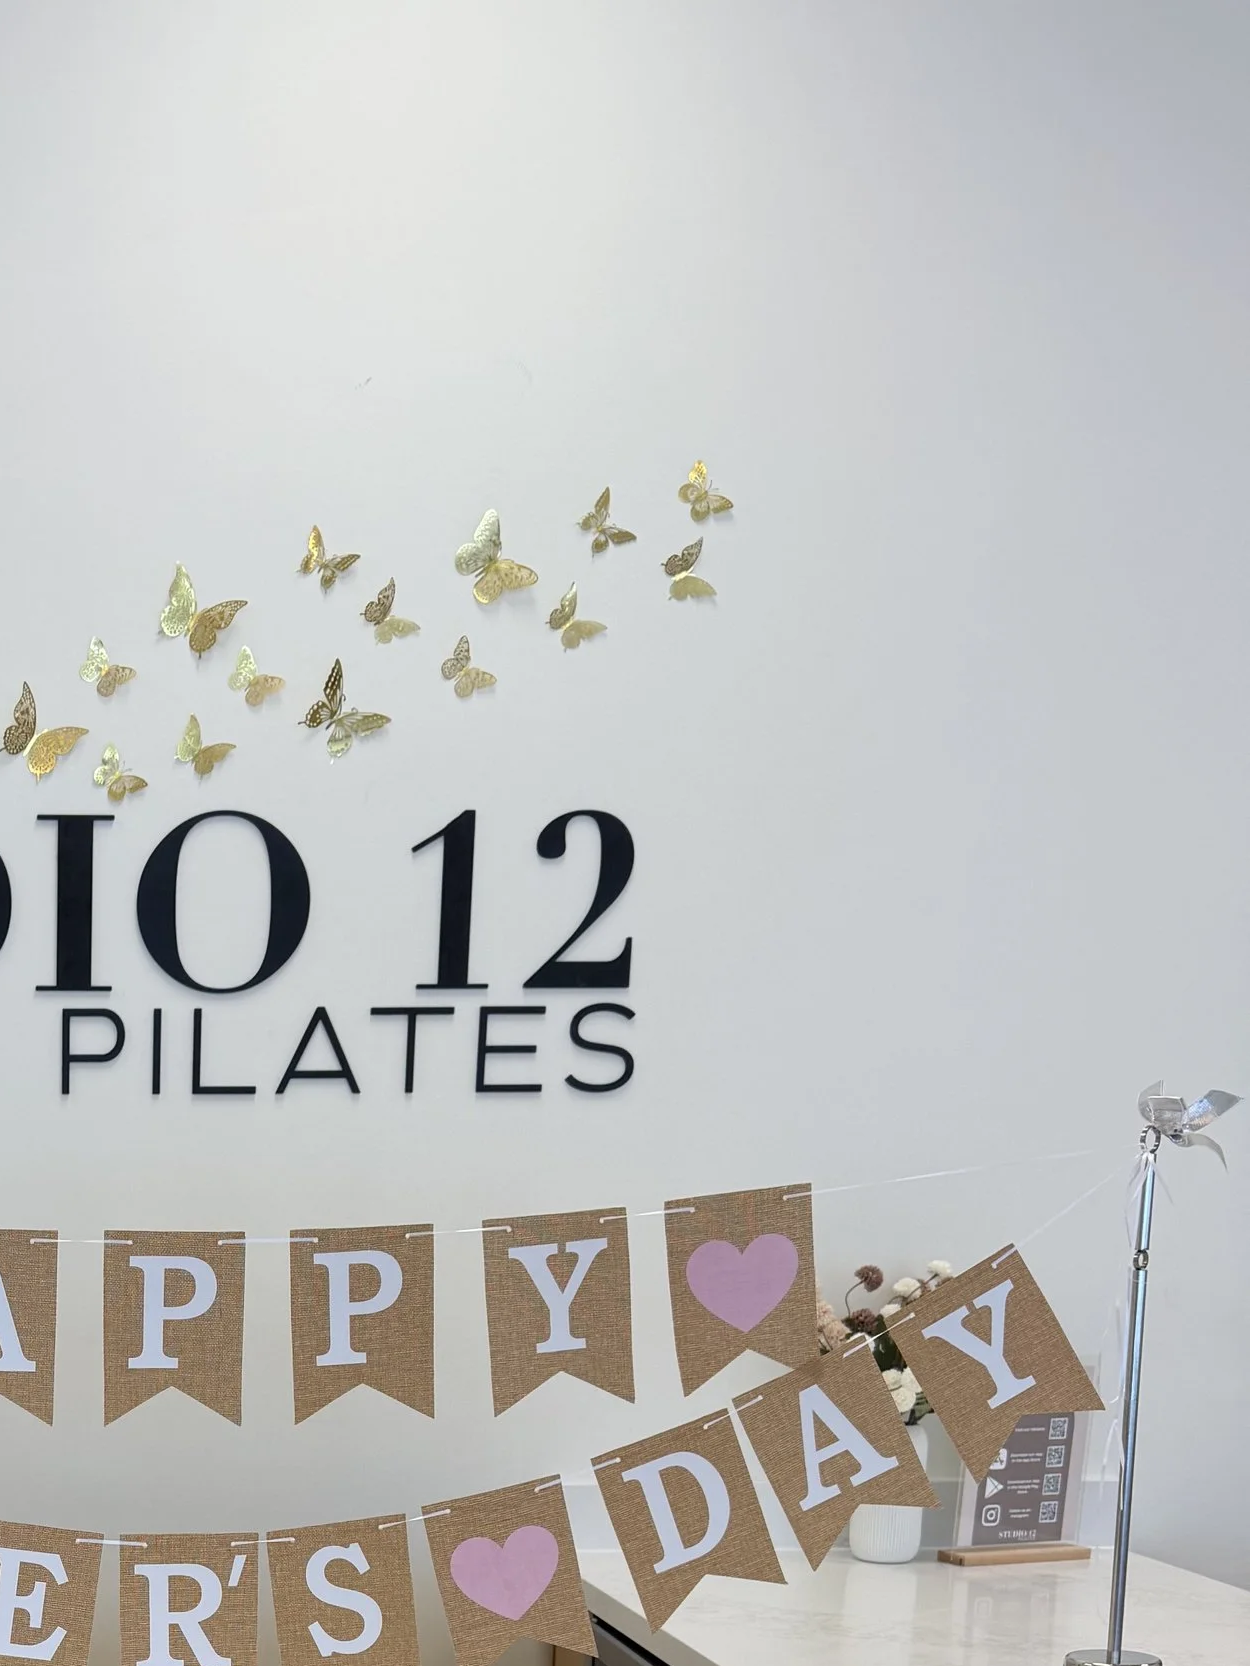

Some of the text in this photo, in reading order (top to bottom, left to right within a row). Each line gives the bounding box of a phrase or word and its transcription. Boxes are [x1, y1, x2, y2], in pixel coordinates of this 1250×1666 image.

[412, 809, 634, 989] 12
[62, 1003, 635, 1094] PILATES
[622, 1280, 1035, 1573] DAY
